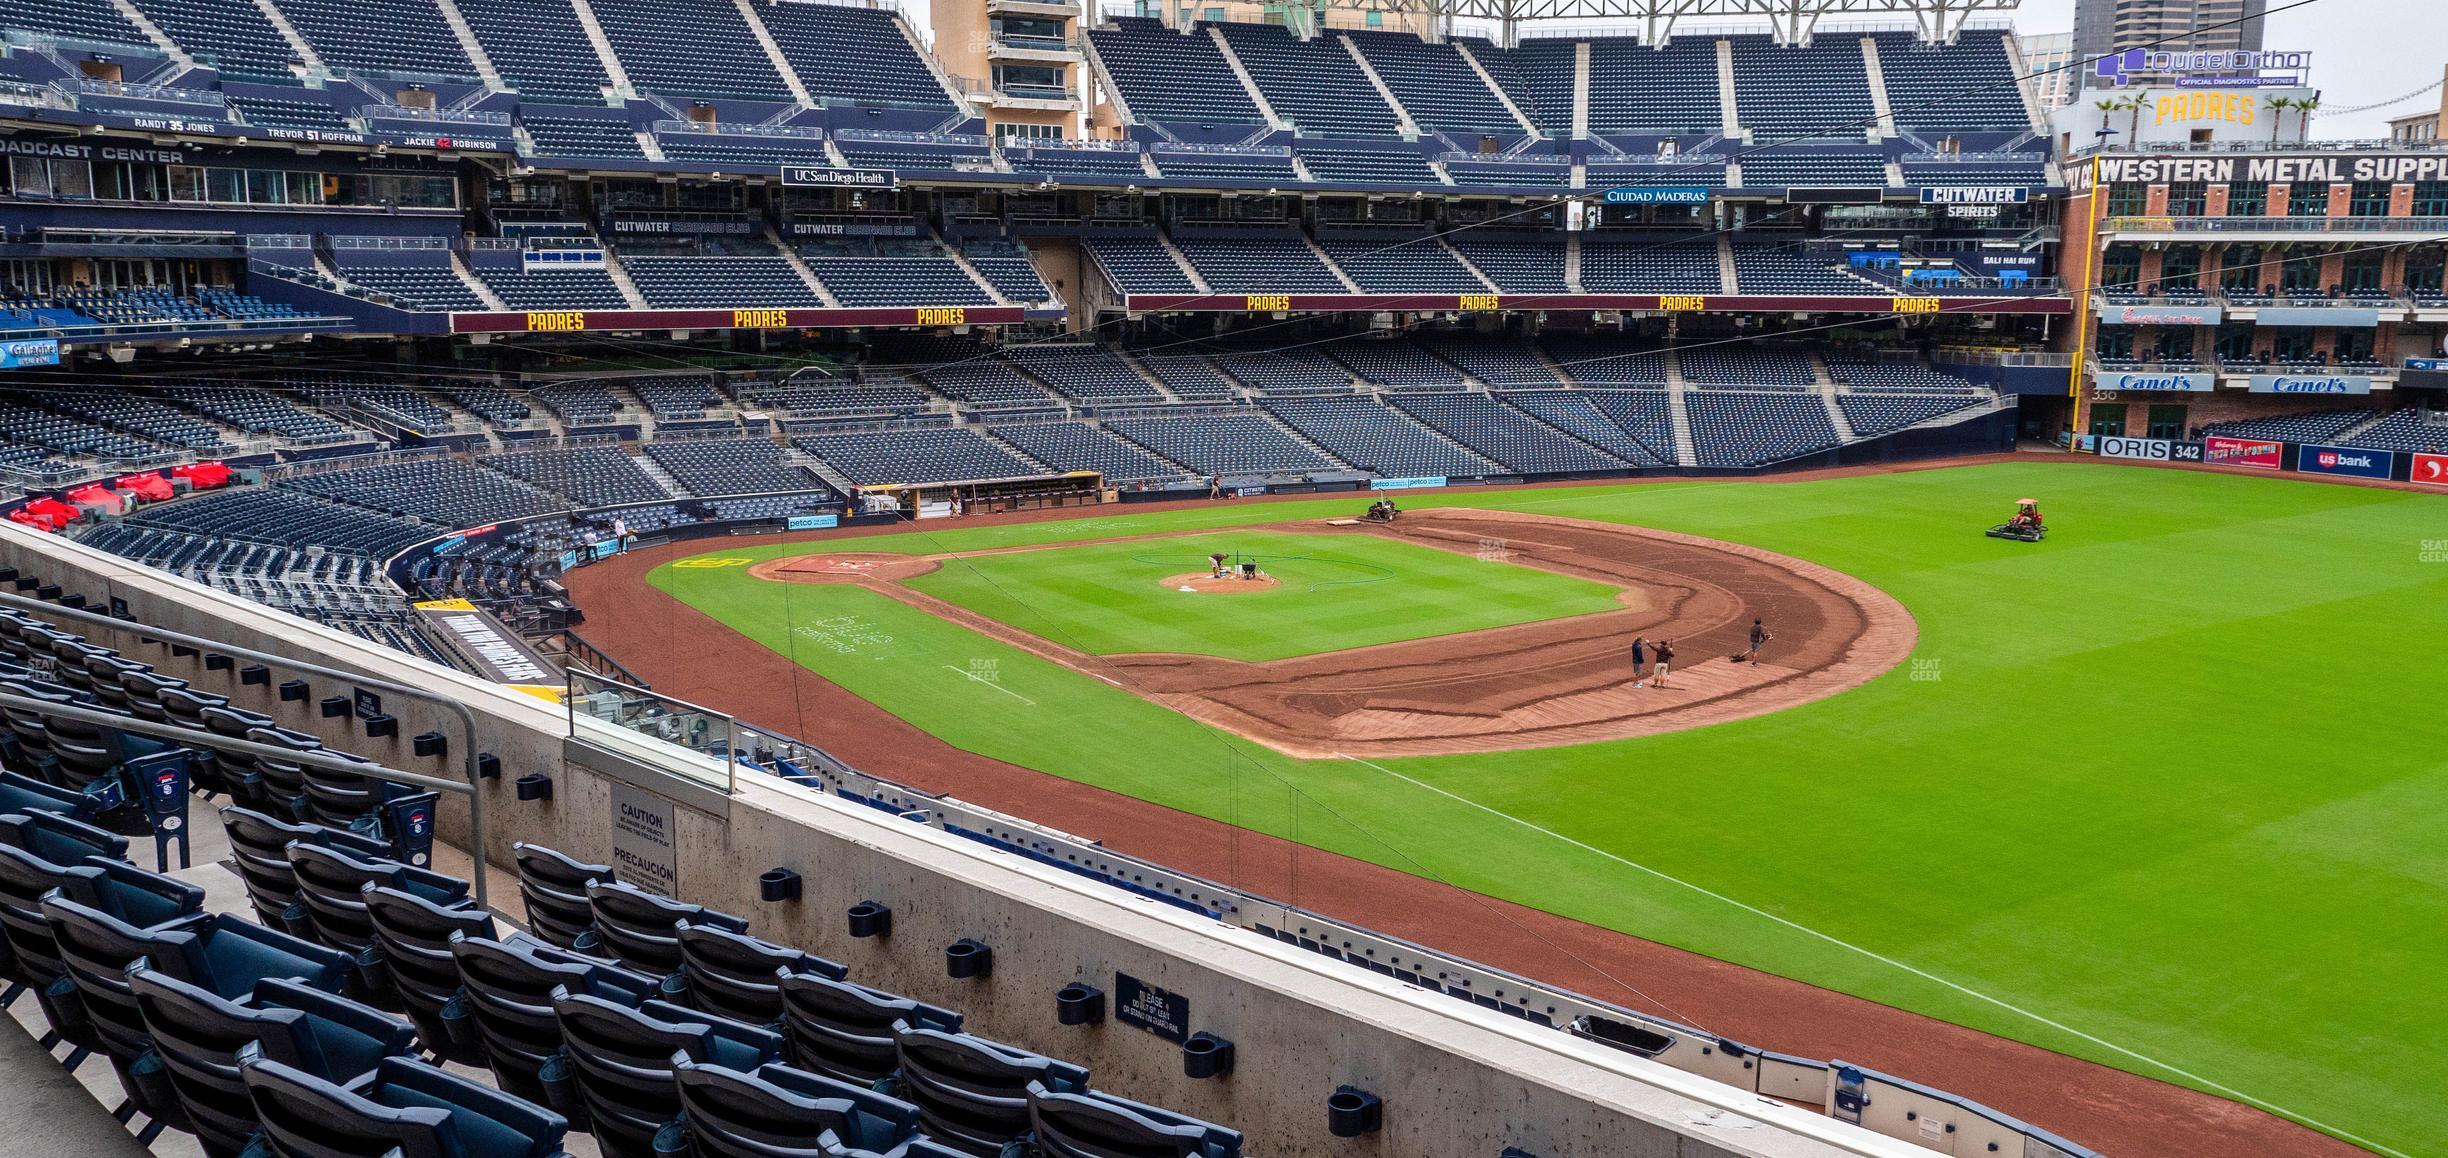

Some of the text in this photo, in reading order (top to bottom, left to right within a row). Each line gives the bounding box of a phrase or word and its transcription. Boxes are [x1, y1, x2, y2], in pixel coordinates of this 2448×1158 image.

[2152, 50, 2301, 74] QuidelOrtho
[2156, 91, 2256, 126] PADRES
[135, 119, 215, 133] RANDY 35 JONES
[267, 129, 363, 142] TREVOR 51 HOFFMAN
[404, 137, 496, 149] JACKIE 42 ROBINSON
[102, 148, 184, 163] CENTER
[794, 170, 885, 184] UC San Diego Health
[2099, 160, 2234, 182] WESTERN
[2248, 159, 2344, 181] METAL
[1608, 192, 1706, 201] CIUDAD MADERAS
[1932, 188, 2015, 202] CUTWATER
[1948, 206, 1997, 217] SPIRITS
[615, 222, 670, 232] CUTWATER
[794, 224, 843, 234] CUTWATER
[1247, 296, 1289, 310] PADRES
[1460, 296, 1498, 310] PADRES
[1659, 296, 1703, 310] PADRES
[1893, 298, 1940, 312] PADRES
[528, 312, 584, 330] PADRES
[734, 310, 787, 327] PADRES
[917, 308, 964, 324] PADRES
[2120, 374, 2192, 390] Canel's
[2273, 376, 2347, 392] Canel's
[2092, 390, 2117, 400] 330
[2104, 438, 2167, 458] ORIS
[2175, 446, 2199, 459] 342
[2320, 454, 2372, 467] us bank
[790, 520, 812, 528] petco
[621, 803, 663, 829] CAUTION
[614, 846, 673, 882] PRECAUCIÓN
[1139, 990, 1163, 1008] EASE
